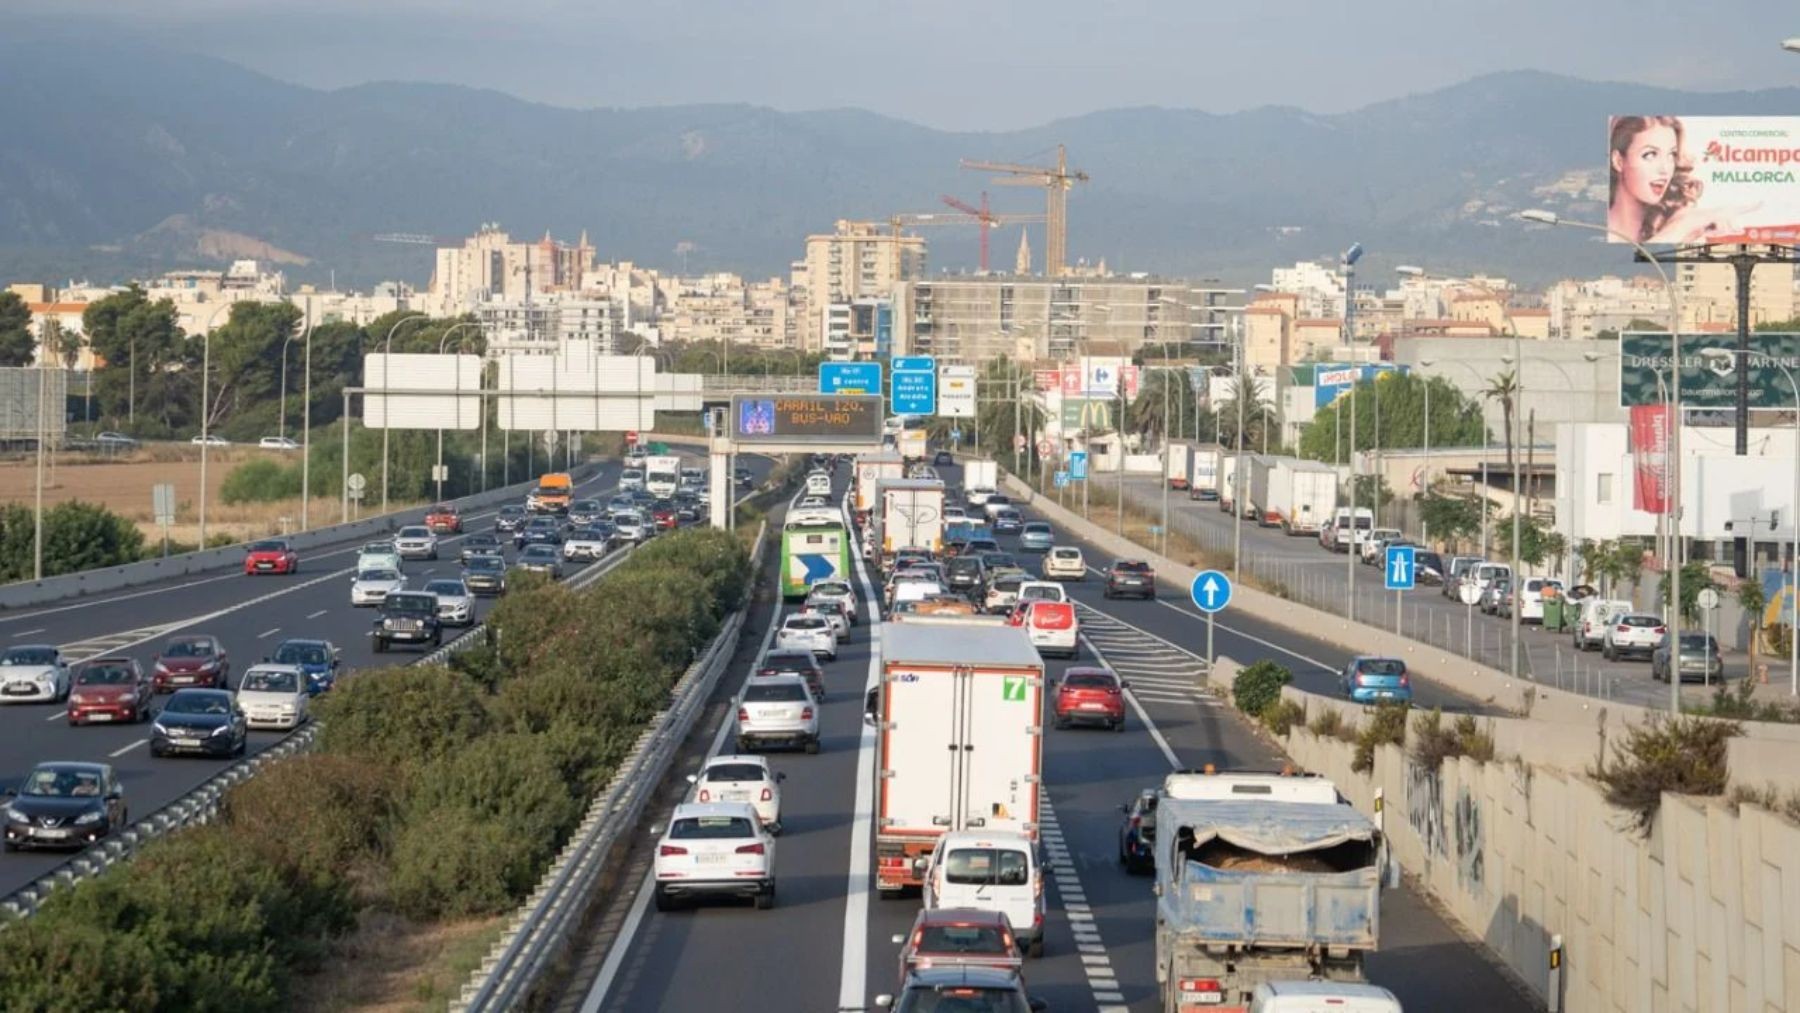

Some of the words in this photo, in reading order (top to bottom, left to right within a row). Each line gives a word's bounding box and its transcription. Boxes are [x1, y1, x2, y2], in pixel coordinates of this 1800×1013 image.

[1712, 171, 1795, 183] MALLORCA
[791, 413, 850, 424] BUS-VAO
[1007, 677, 1022, 699] 7
